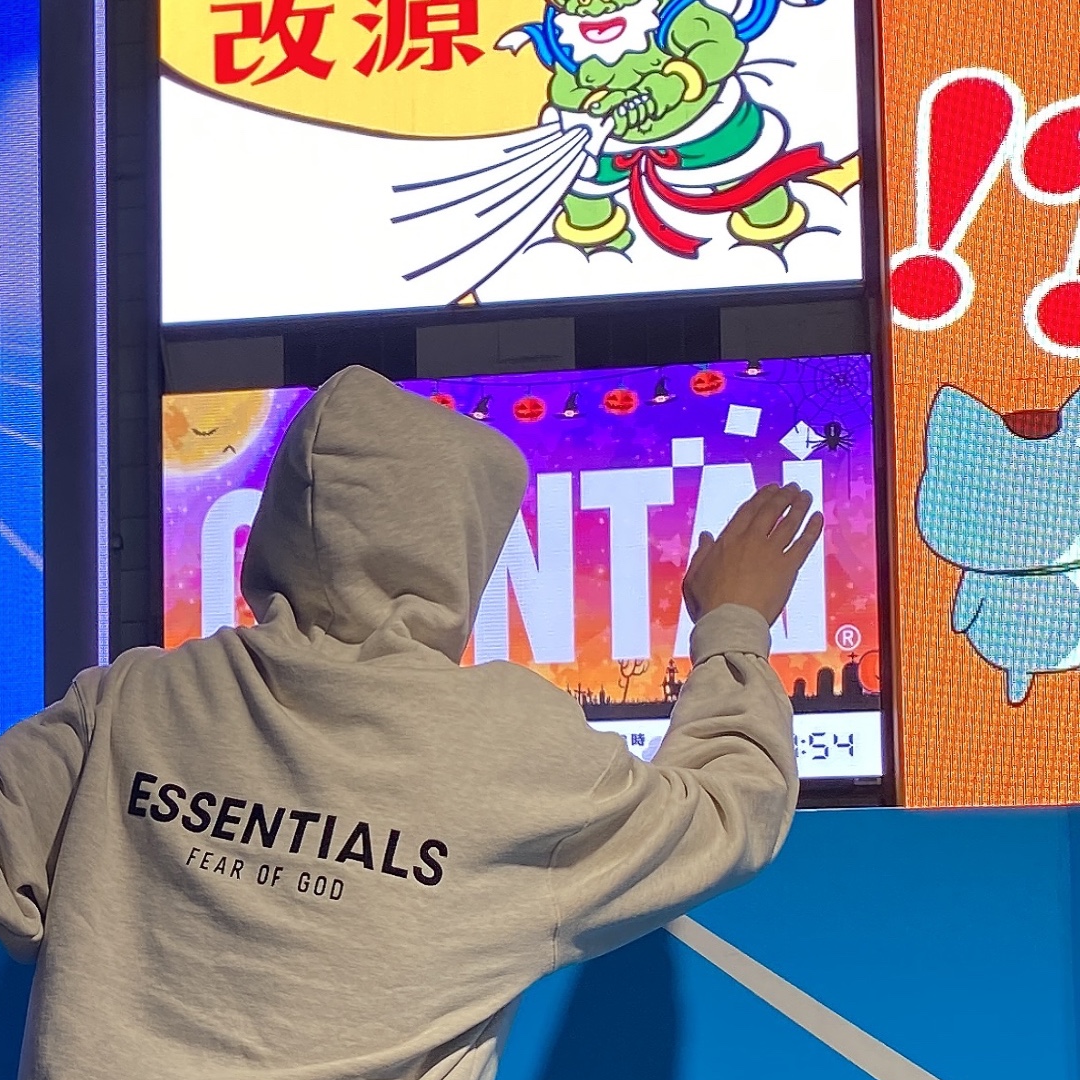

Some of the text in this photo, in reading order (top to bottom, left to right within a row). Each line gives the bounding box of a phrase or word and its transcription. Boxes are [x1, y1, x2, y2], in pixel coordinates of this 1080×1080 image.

[210, 0, 486, 86] 改源
[127, 770, 449, 887] ESSENTIALS
[185, 847, 345, 901] FEAR OF GOD
